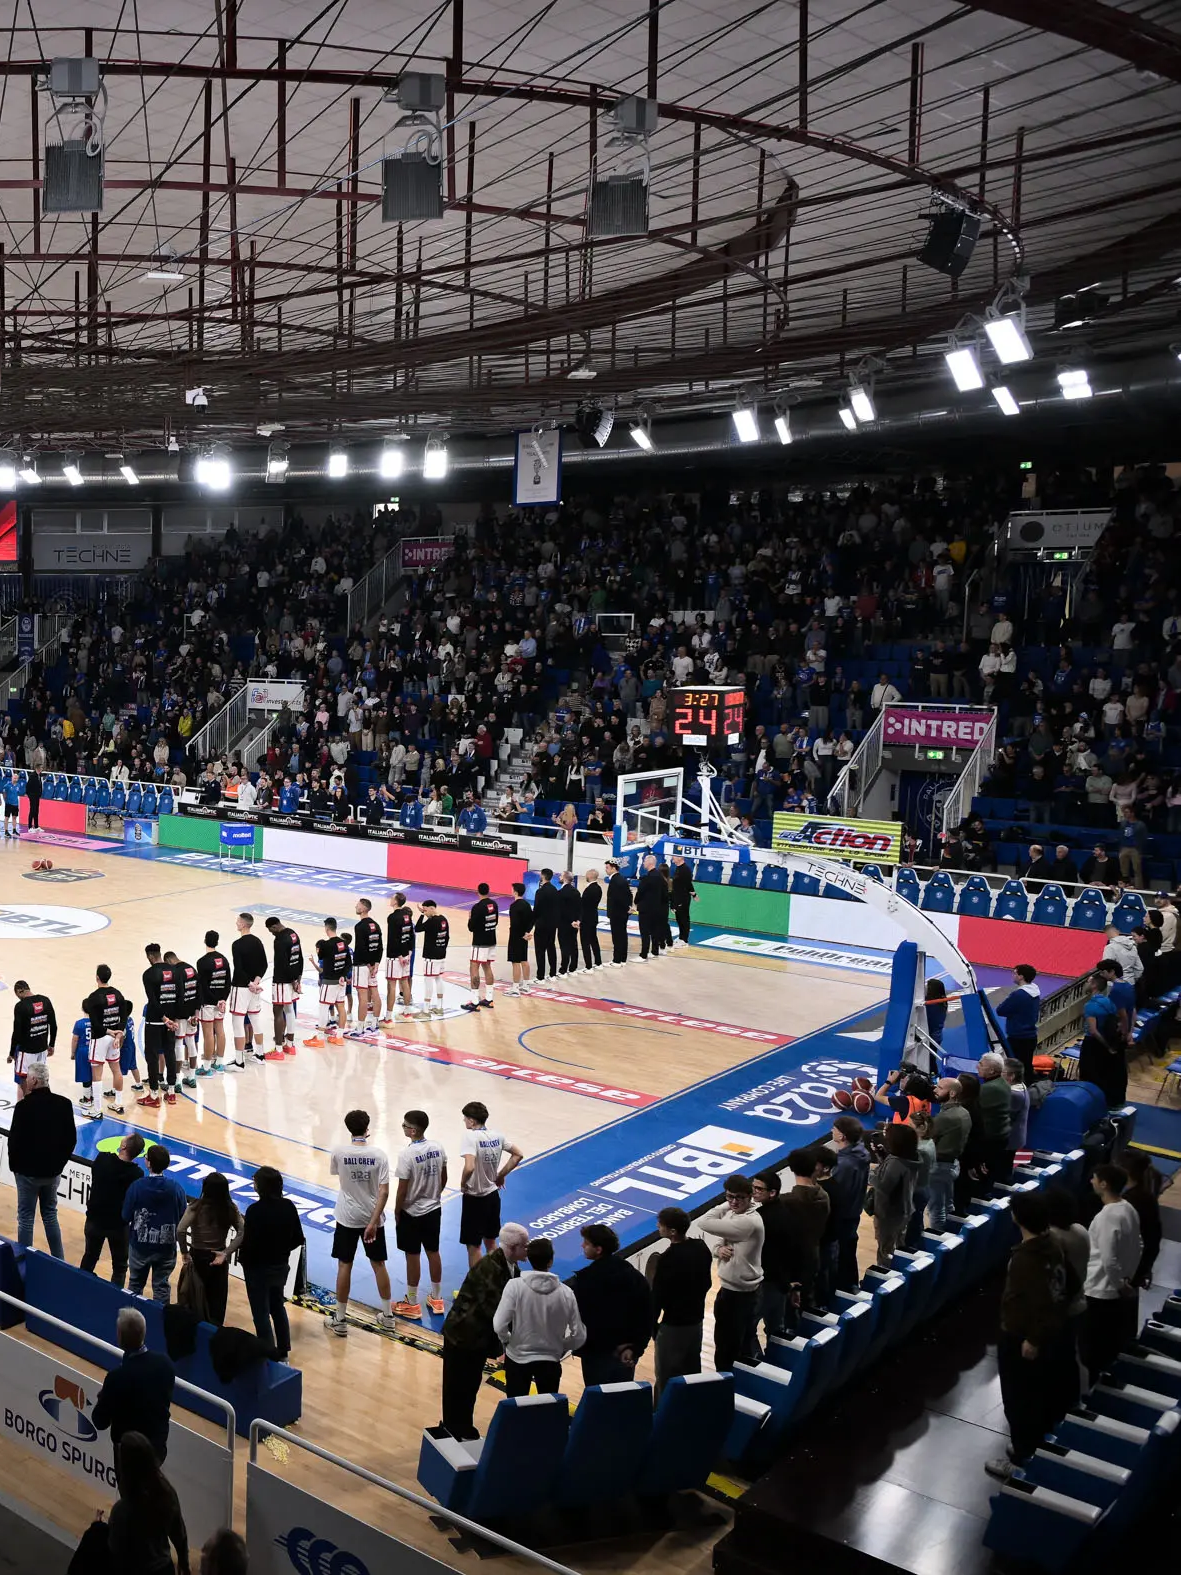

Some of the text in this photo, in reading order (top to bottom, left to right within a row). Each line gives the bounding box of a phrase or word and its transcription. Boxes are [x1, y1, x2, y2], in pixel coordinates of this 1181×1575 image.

[53, 546, 131, 563] TECHNE
[412, 547, 453, 561] INTRE
[684, 693, 719, 706] 3:27
[674, 708, 717, 735] 24
[723, 706, 743, 735] 24
[902, 718, 989, 741] INTRED
[232, 831, 252, 839] molten
[683, 845, 707, 857] BTL
[174, 852, 412, 892] BRESCIA
[807, 862, 866, 896] TECHNE
[611, 1003, 781, 1041] arcese
[462, 1056, 645, 1101] arcese
[717, 1083, 777, 1112] COMPANY
[343, 1157, 376, 1167] BALL CREW
[425, 1150, 440, 1160] CREW
[601, 1146, 748, 1201] BTL
[529, 1196, 595, 1230] LOMBARDO
[585, 1202, 615, 1216] DEL
[593, 1208, 635, 1227] BANC
[4, 1407, 118, 1489] BORGO SPURG
